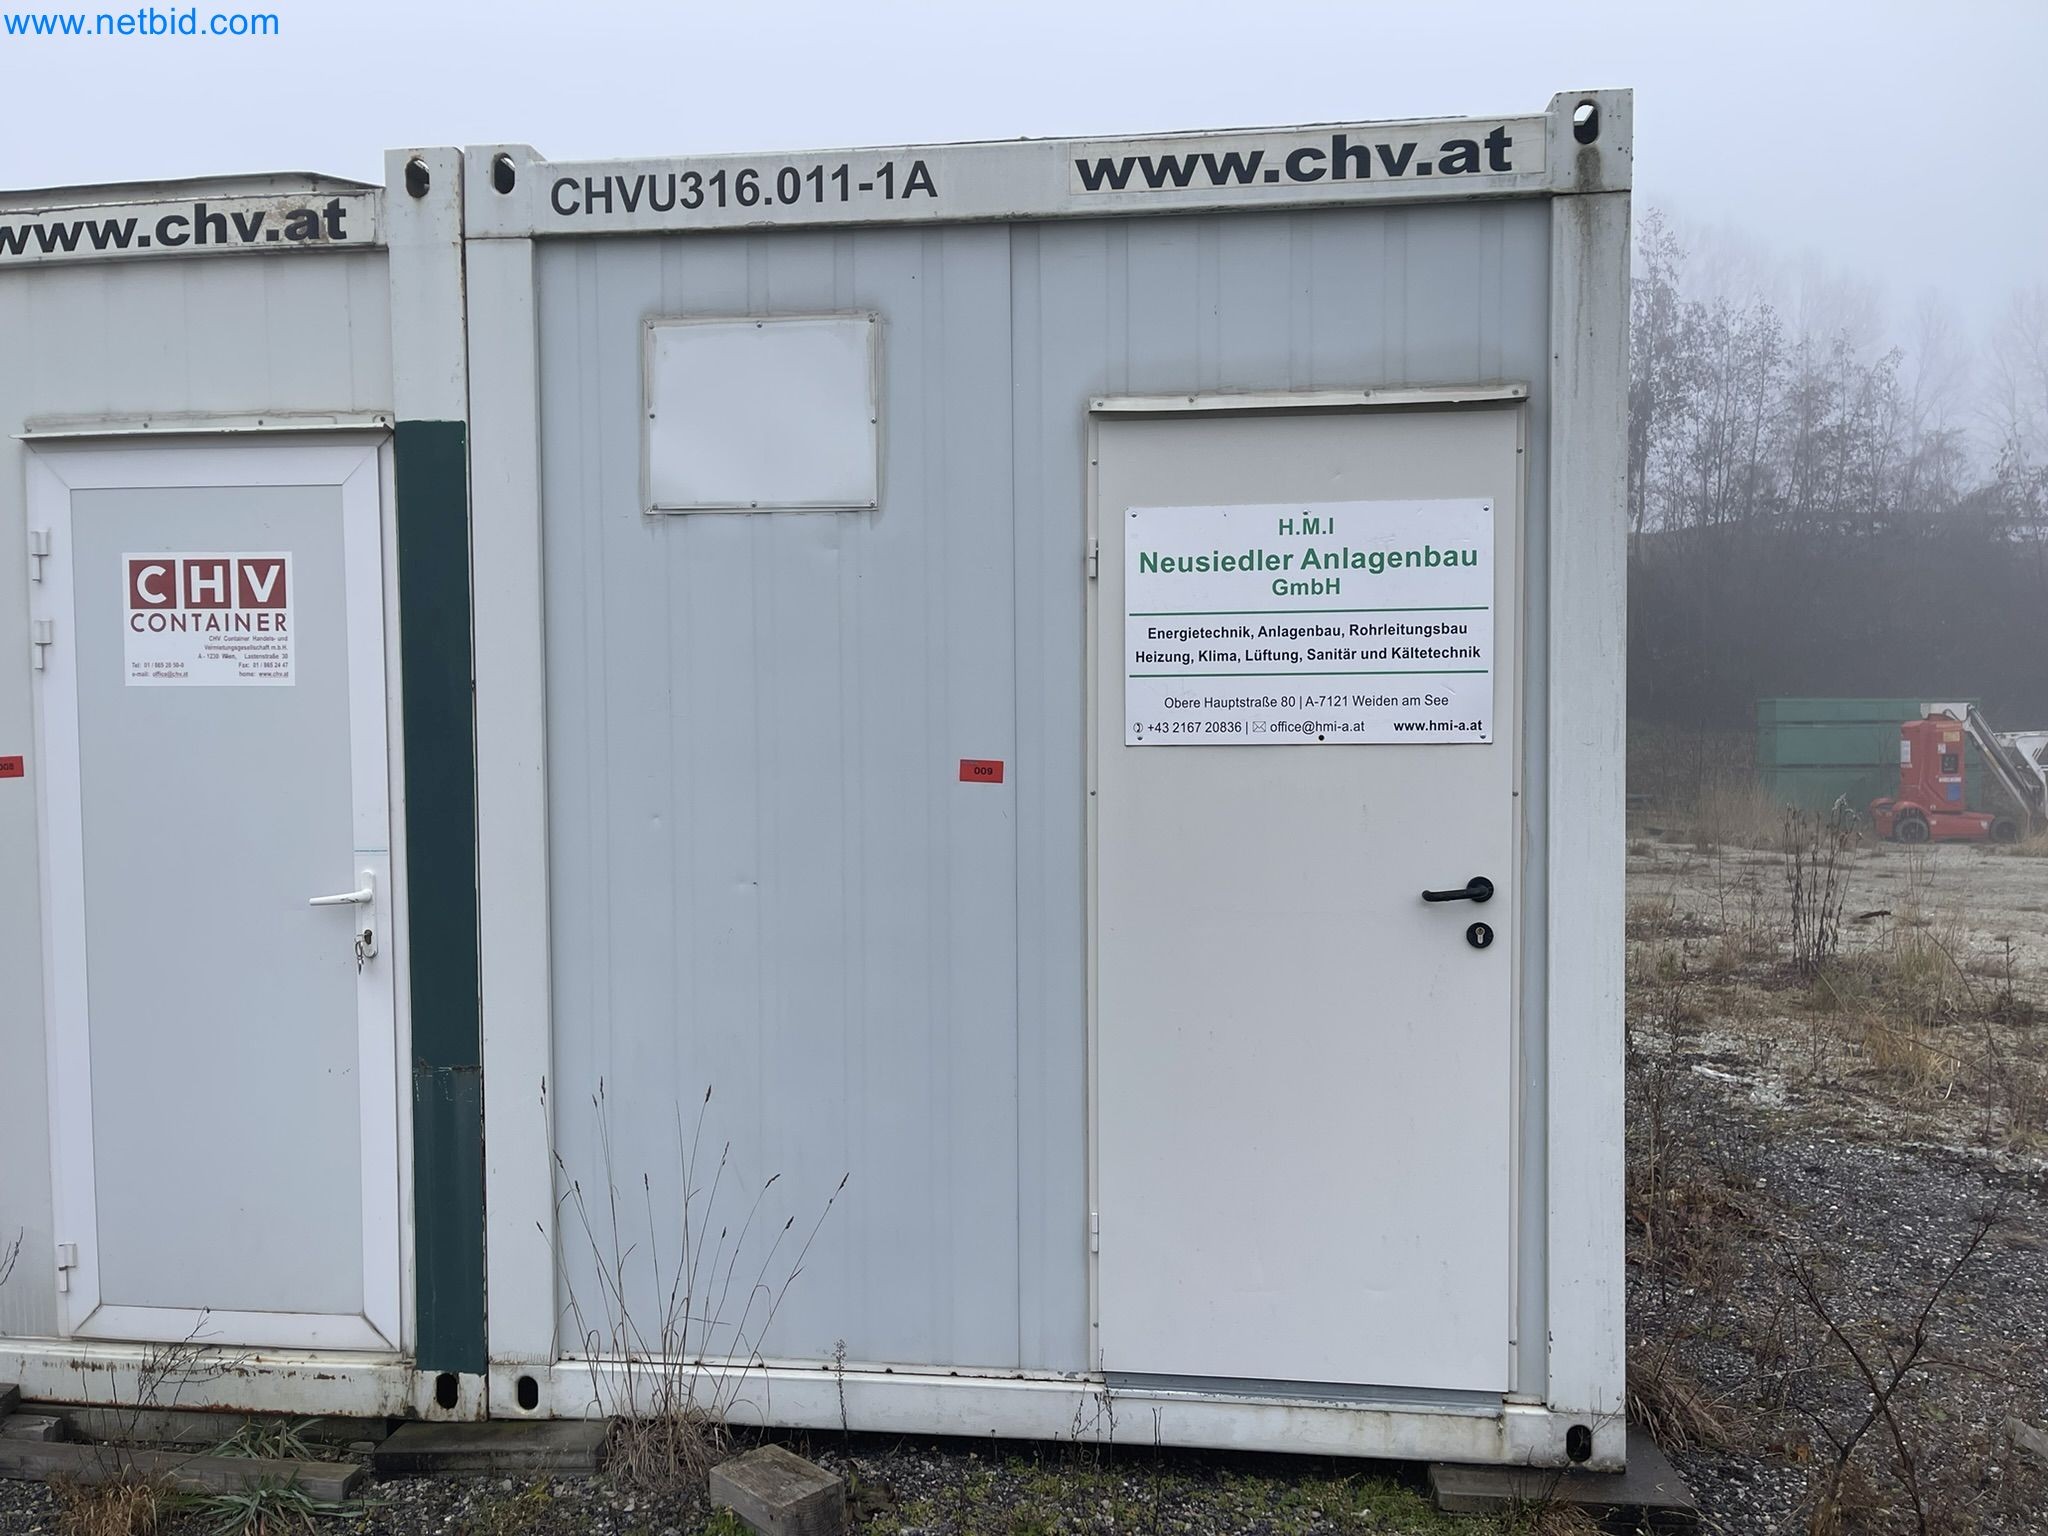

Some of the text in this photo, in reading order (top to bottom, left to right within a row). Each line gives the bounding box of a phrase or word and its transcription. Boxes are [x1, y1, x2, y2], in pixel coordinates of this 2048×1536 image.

[1075, 125, 1513, 192] www.chv.at
[550, 160, 938, 216] CHVU316.011-1A
[1279, 517, 1334, 536] H.M.I
[1139, 545, 1478, 575] Neusiedler Anlagenbau
[137, 565, 280, 603] CHV
[1271, 577, 1341, 596] GmbH
[130, 613, 287, 633] CONTAINER
[1148, 622, 1467, 642] Energietechnik, Anlagenbau, Rohrleitungsbau
[1135, 645, 1481, 665] Heizung, Klima, Lüftung, Sanitär und Kältetechnik
[1164, 697, 1200, 709] Obere
[1204, 696, 1277, 710] Hauptstraße
[1281, 696, 1296, 707] 80
[1305, 695, 1348, 707] A-7121
[1352, 695, 1398, 706] Weiden
[1401, 697, 1421, 706] am
[1424, 694, 1448, 706] See
[1148, 722, 1169, 733] +43
[1172, 721, 1201, 733] 2167
[1205, 721, 1242, 733] 20836
[1270, 720, 1365, 735] office@hmi-a.at
[1393, 720, 1483, 731] www.hmi-a.at
[974, 767, 993, 775] 009
